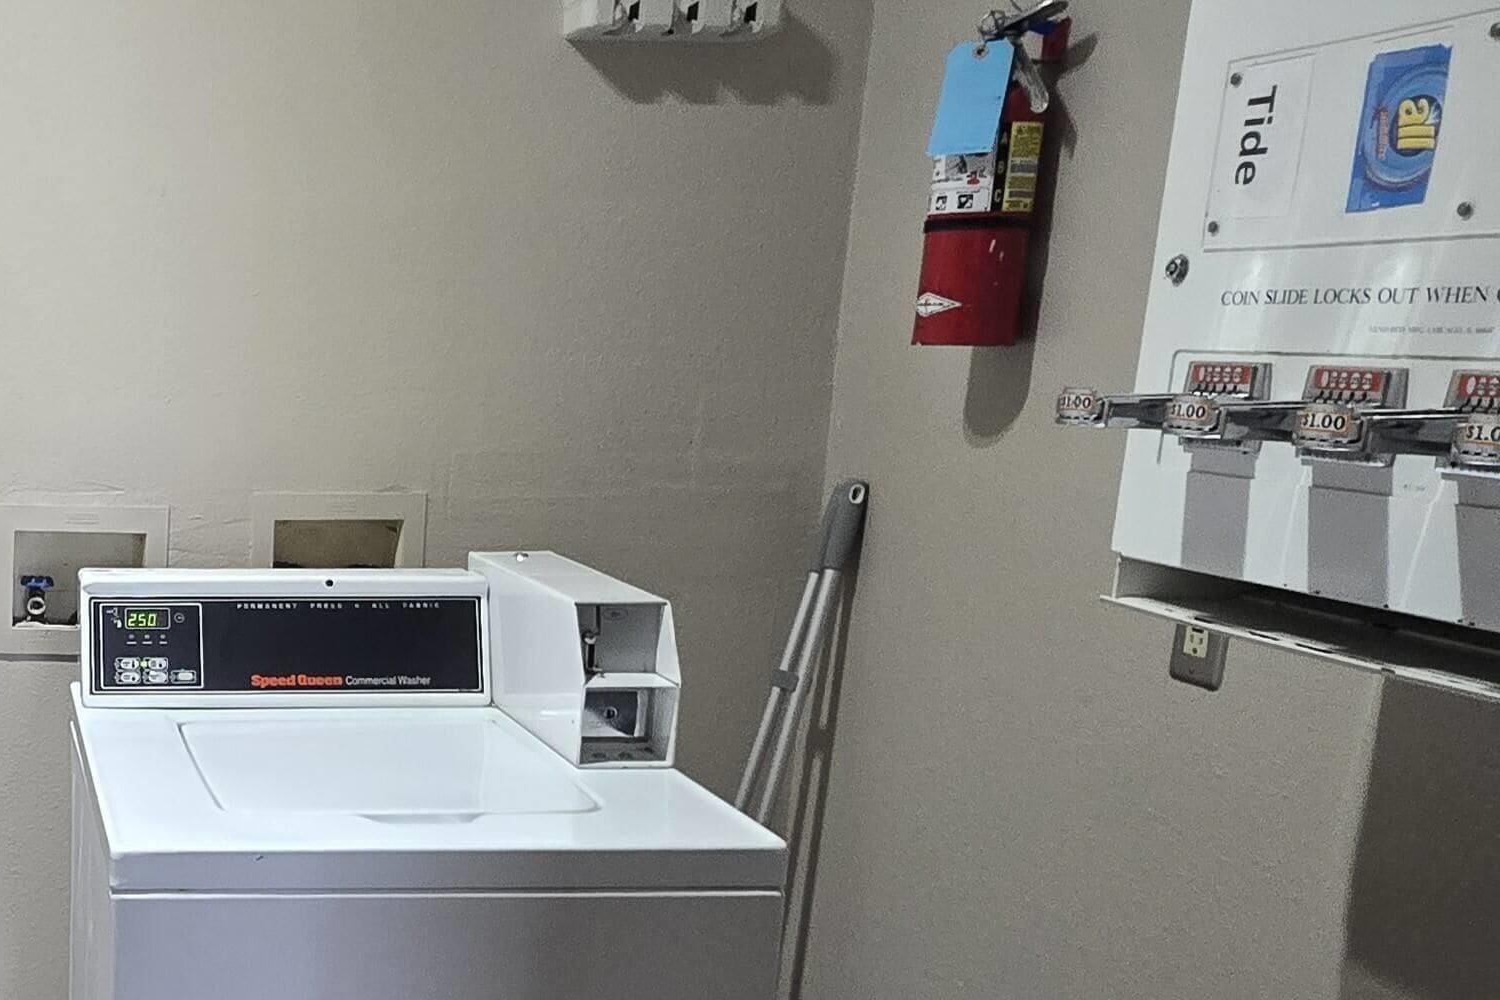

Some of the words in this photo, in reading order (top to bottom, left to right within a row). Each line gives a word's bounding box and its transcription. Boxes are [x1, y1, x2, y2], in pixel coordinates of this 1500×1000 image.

[1396, 98, 1436, 149] all
[1235, 84, 1277, 185] Tide
[1221, 290, 1260, 306] COIN
[1264, 289, 1308, 305] SLIDE
[1313, 288, 1371, 305] LOCKS
[1377, 287, 1419, 304] OUT
[1426, 286, 1488, 304] WHEN
[1171, 403, 1206, 418] $1.00
[1301, 412, 1346, 431] $1.00
[127, 613, 157, 627] 250
[250, 674, 296, 688] Speed
[297, 674, 342, 687] Queen
[345, 676, 396, 686] Commercial
[397, 676, 432, 686] Washer
